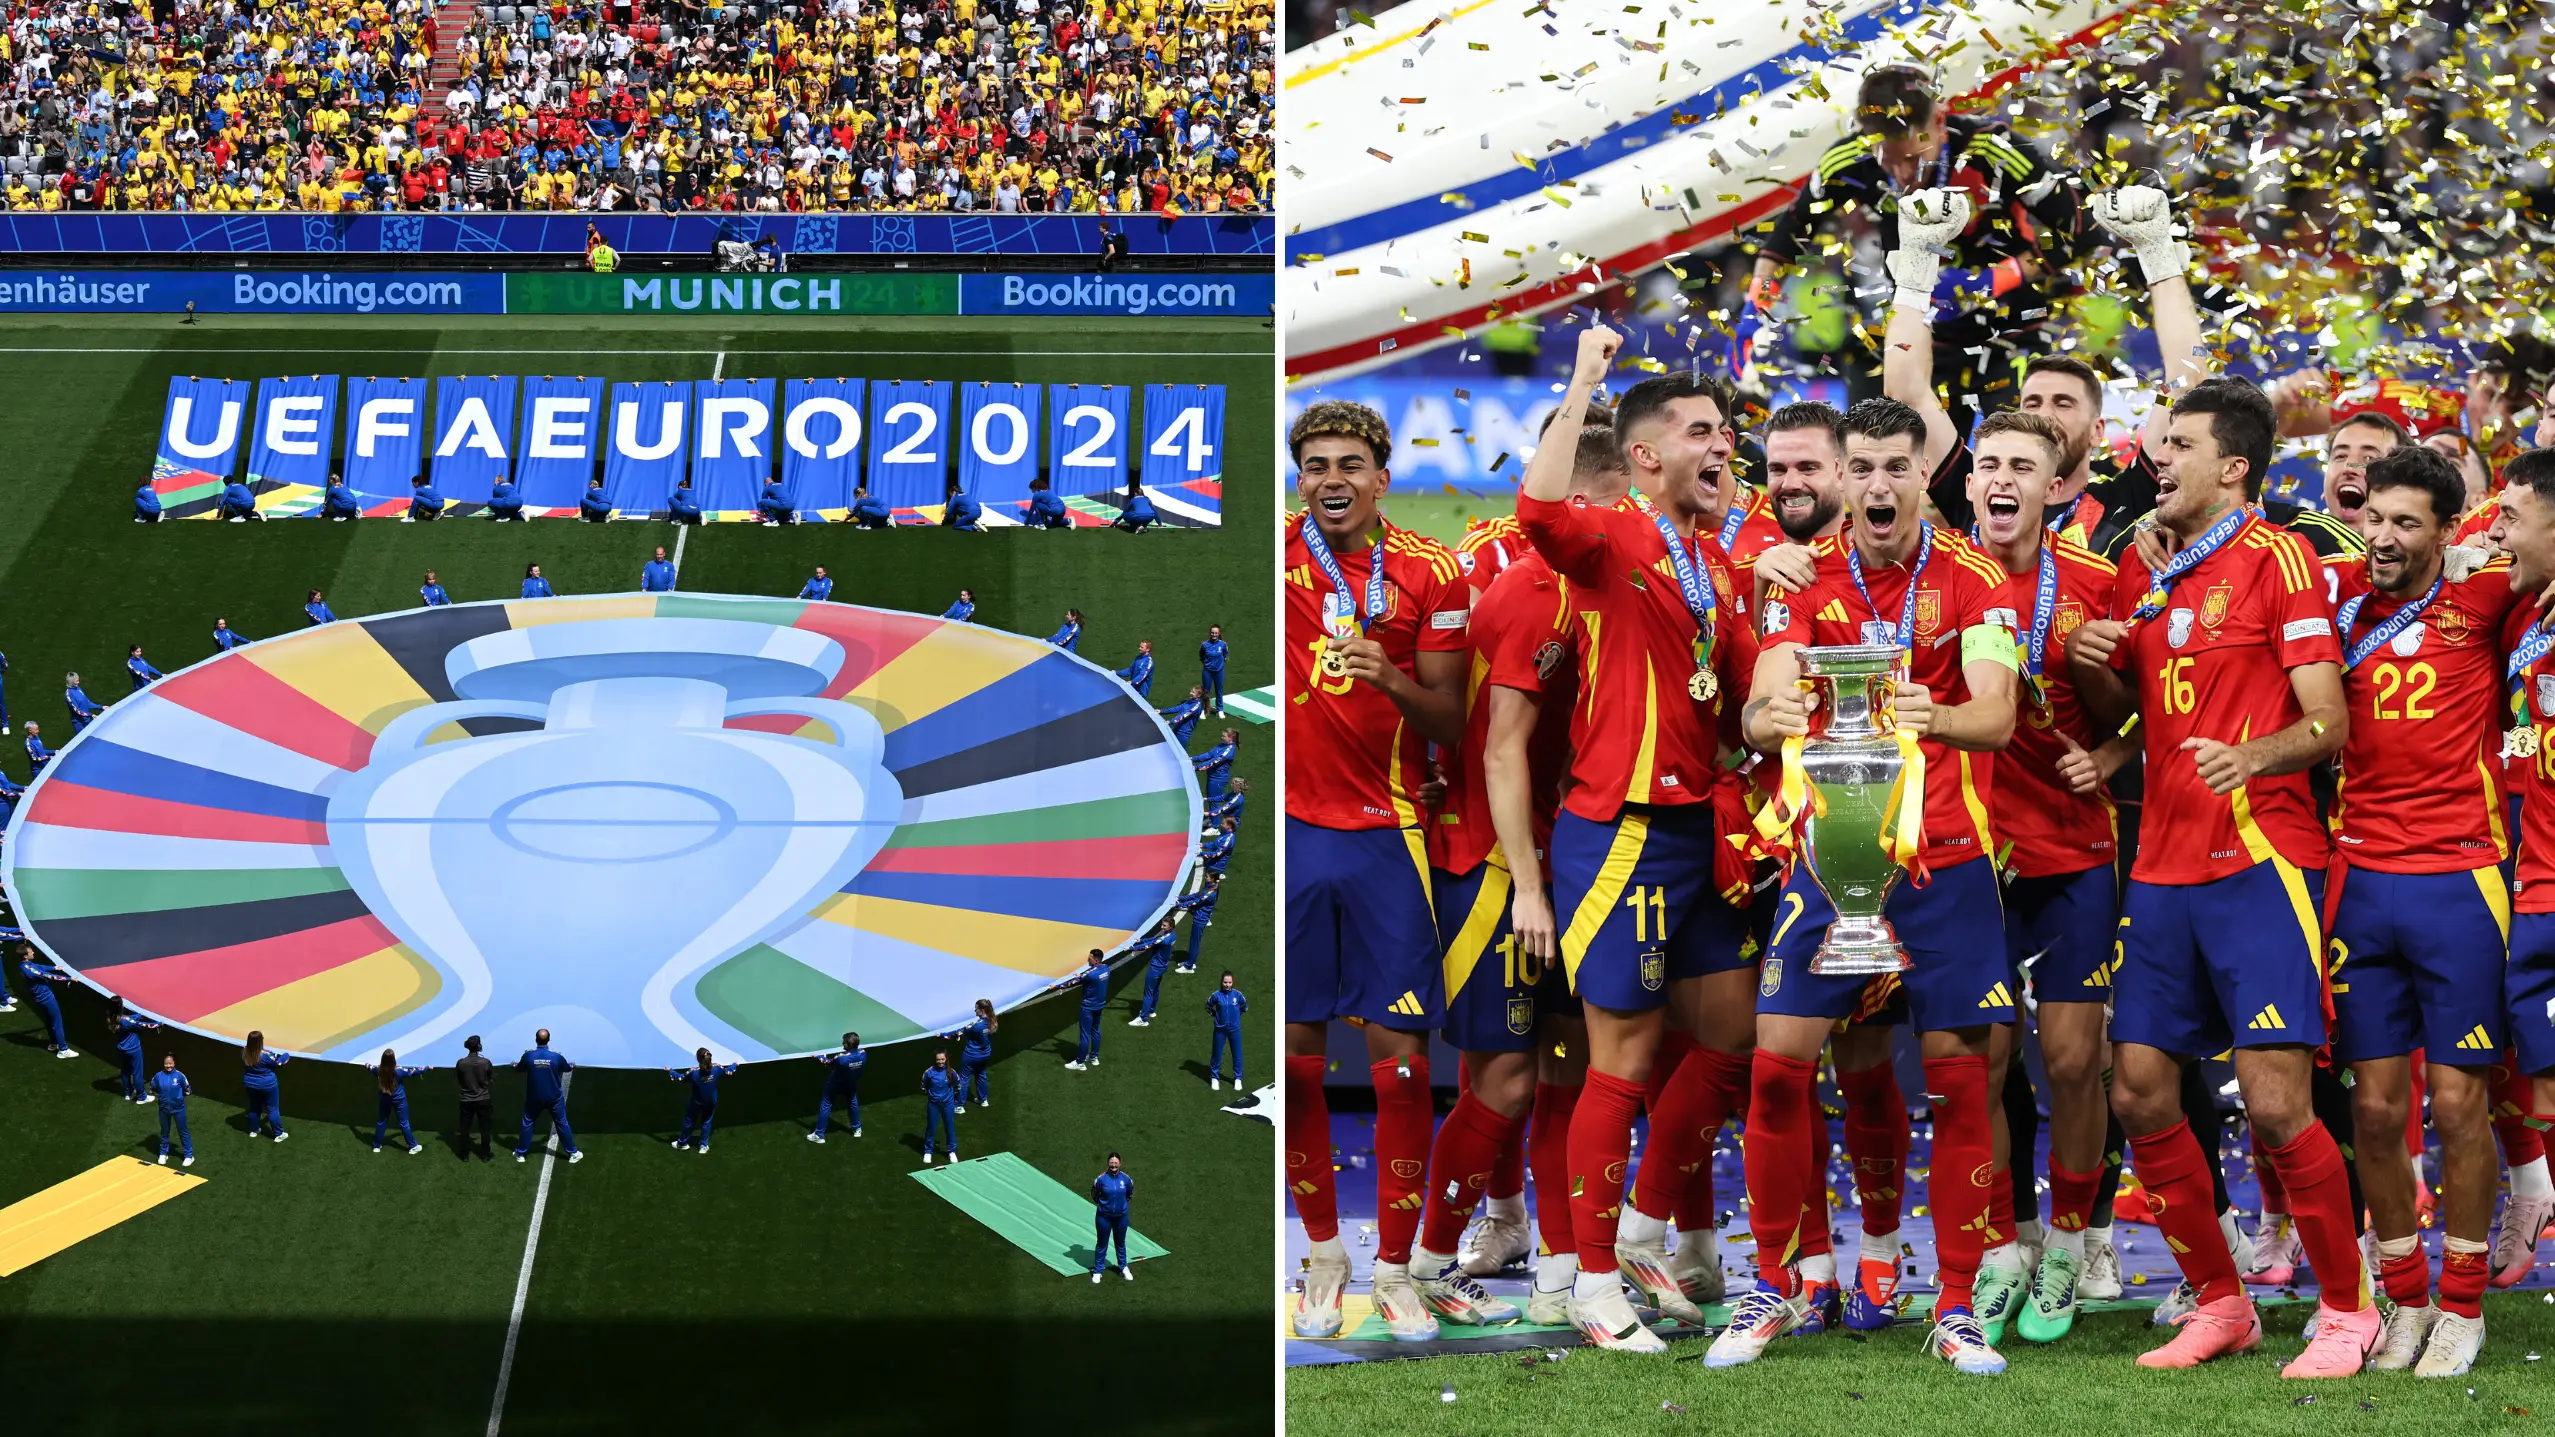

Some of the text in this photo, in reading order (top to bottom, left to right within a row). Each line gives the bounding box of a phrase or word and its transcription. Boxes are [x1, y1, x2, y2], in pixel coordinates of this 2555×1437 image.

[0, 275, 150, 304] enhäuser
[234, 274, 462, 312] Booking.com
[623, 278, 841, 310] MUNICH
[1003, 275, 1236, 314] Booking.com
[1302, 519, 1352, 613] UEFAEURO2024
[1659, 522, 1707, 625] UEFAEURO202
[2164, 514, 2240, 576] UEFAEURO2
[1370, 541, 1384, 617] EFAEURO
[2031, 553, 2055, 664] UEFAEURO2024
[2159, 656, 2196, 715] 16
[2372, 661, 2437, 720] 22
[1626, 885, 1667, 942] 11
[1771, 891, 1805, 947] 7
[2327, 937, 2350, 994] 2
